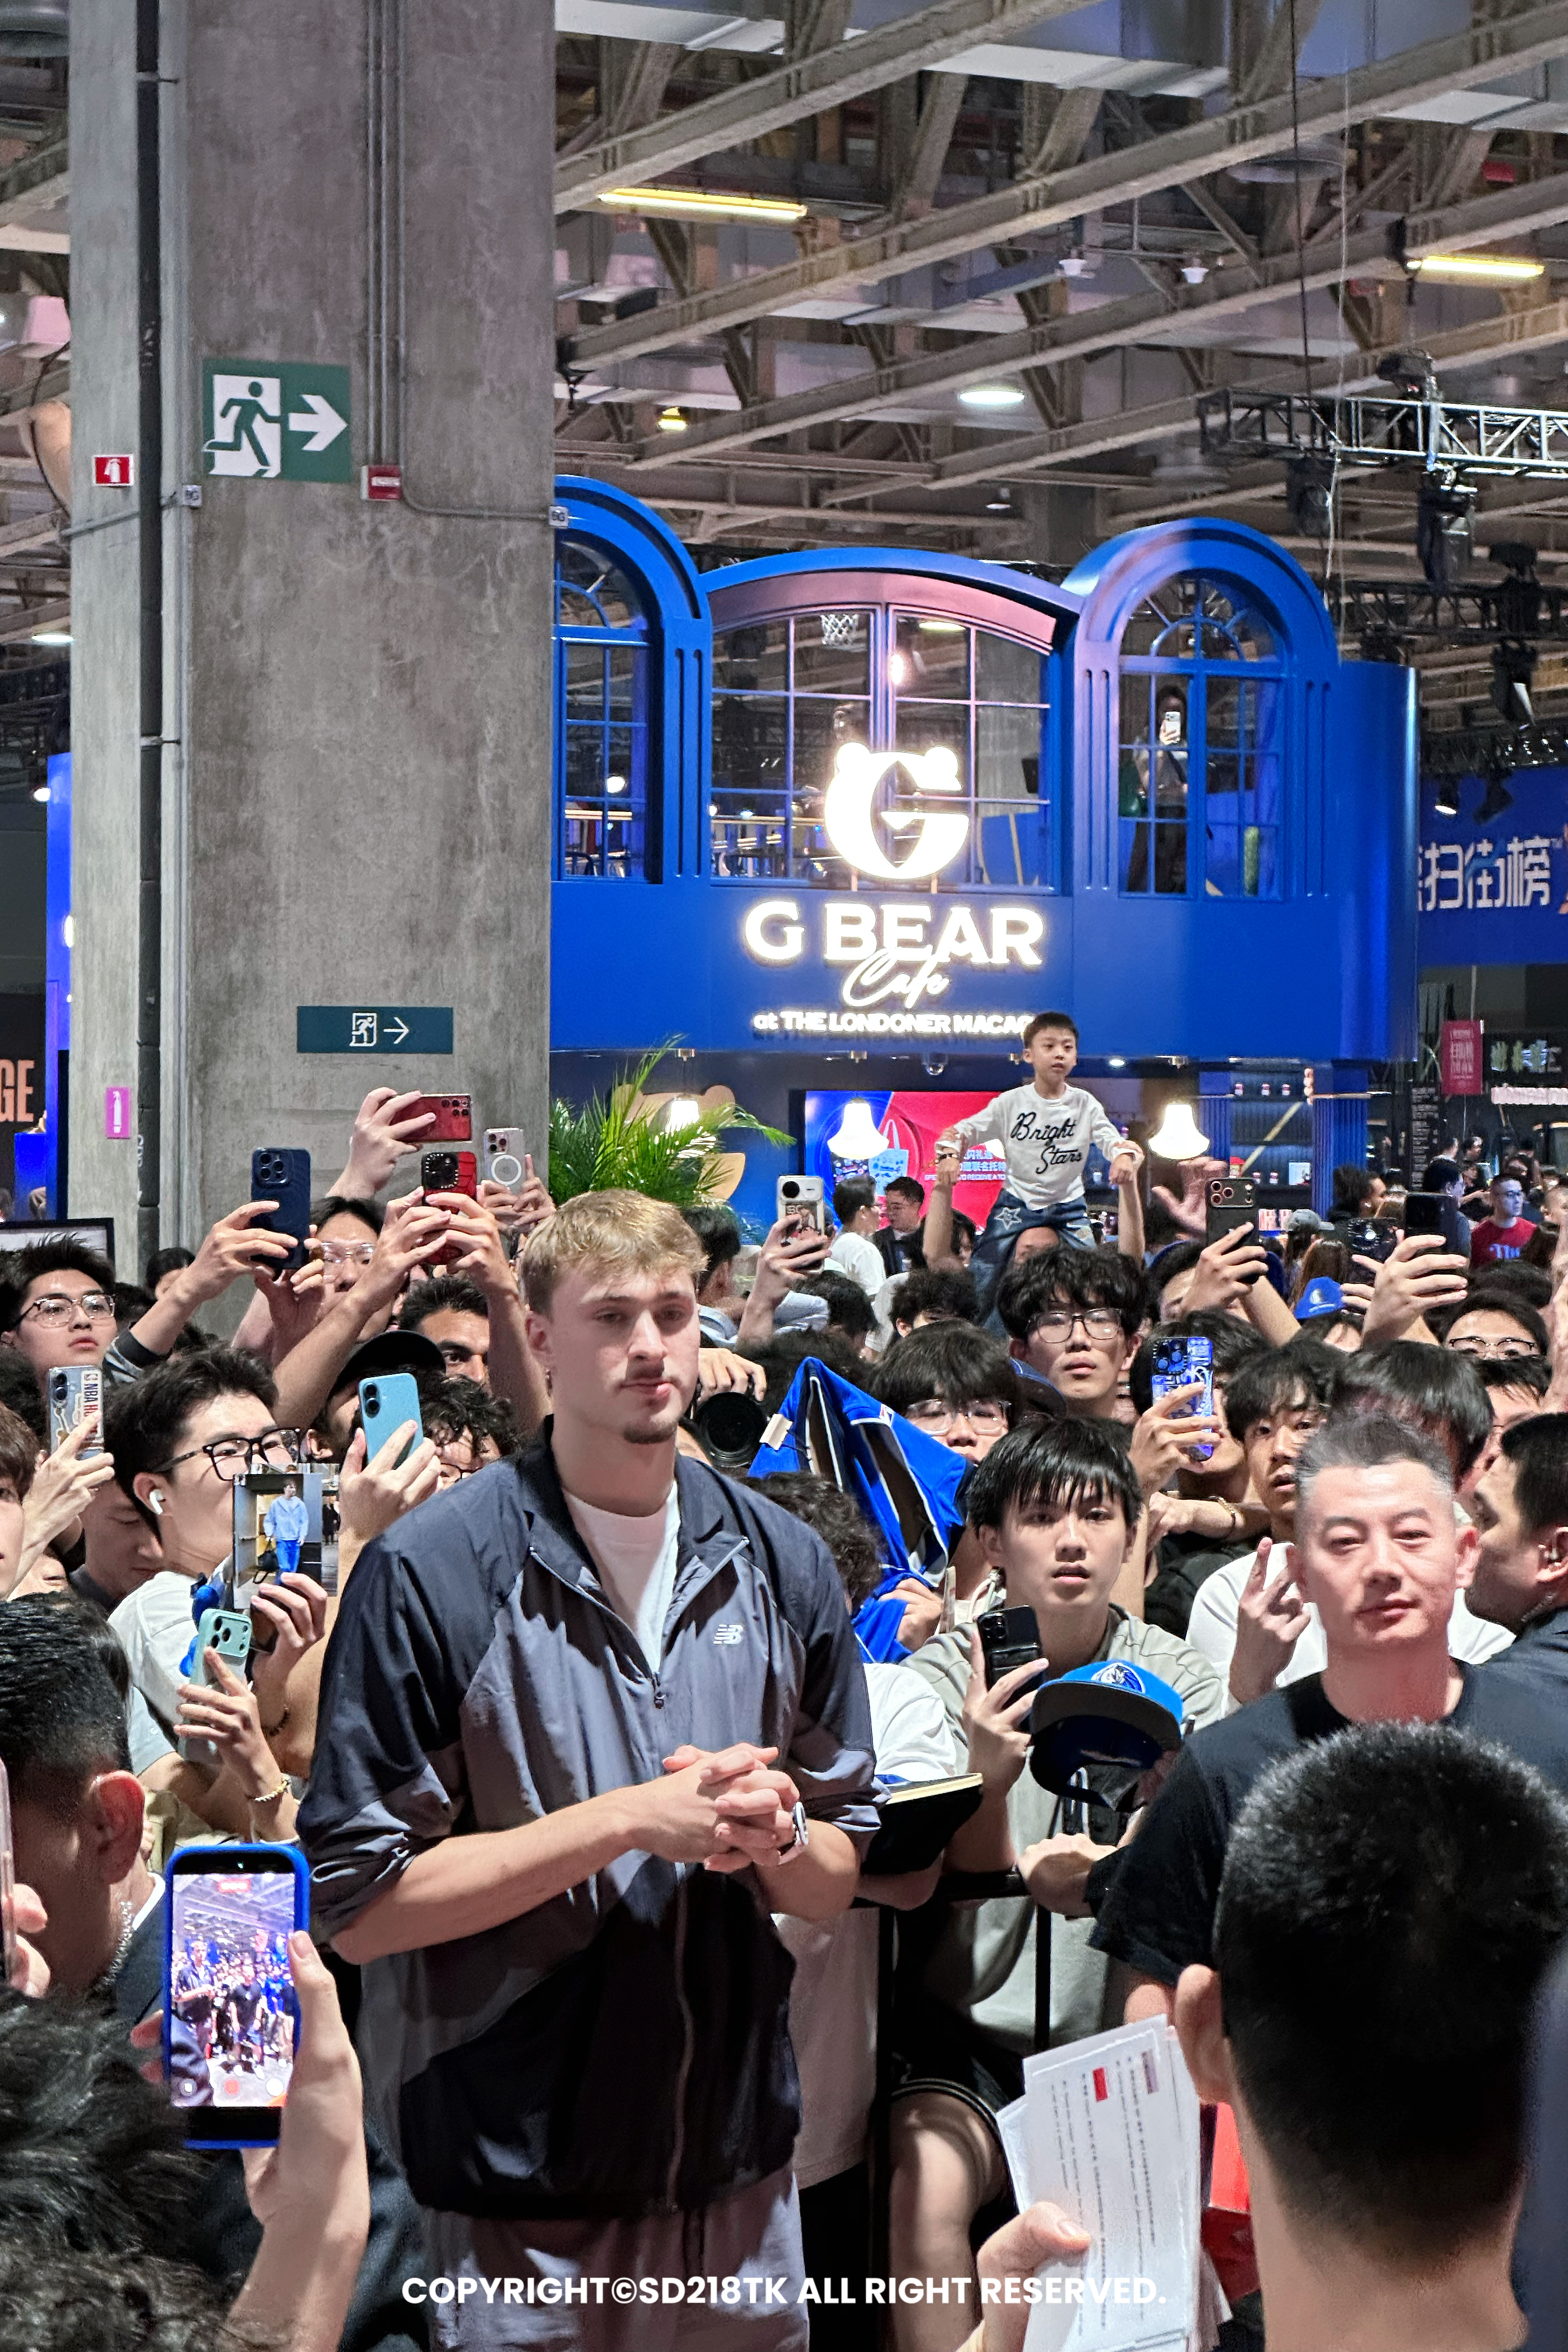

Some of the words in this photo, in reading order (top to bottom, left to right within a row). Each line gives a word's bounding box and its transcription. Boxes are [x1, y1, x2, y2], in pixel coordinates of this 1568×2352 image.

[1418, 836, 1551, 911] 扫街榜
[745, 900, 805, 960] G
[823, 902, 1044, 965] BEAR
[754, 1012, 779, 1030] at
[780, 1011, 828, 1031] THE
[828, 1012, 952, 1033] LONDONER
[1011, 1112, 1076, 1147] Bright
[1036, 1144, 1083, 1174] Stars
[84, 1383, 98, 1403] NBA
